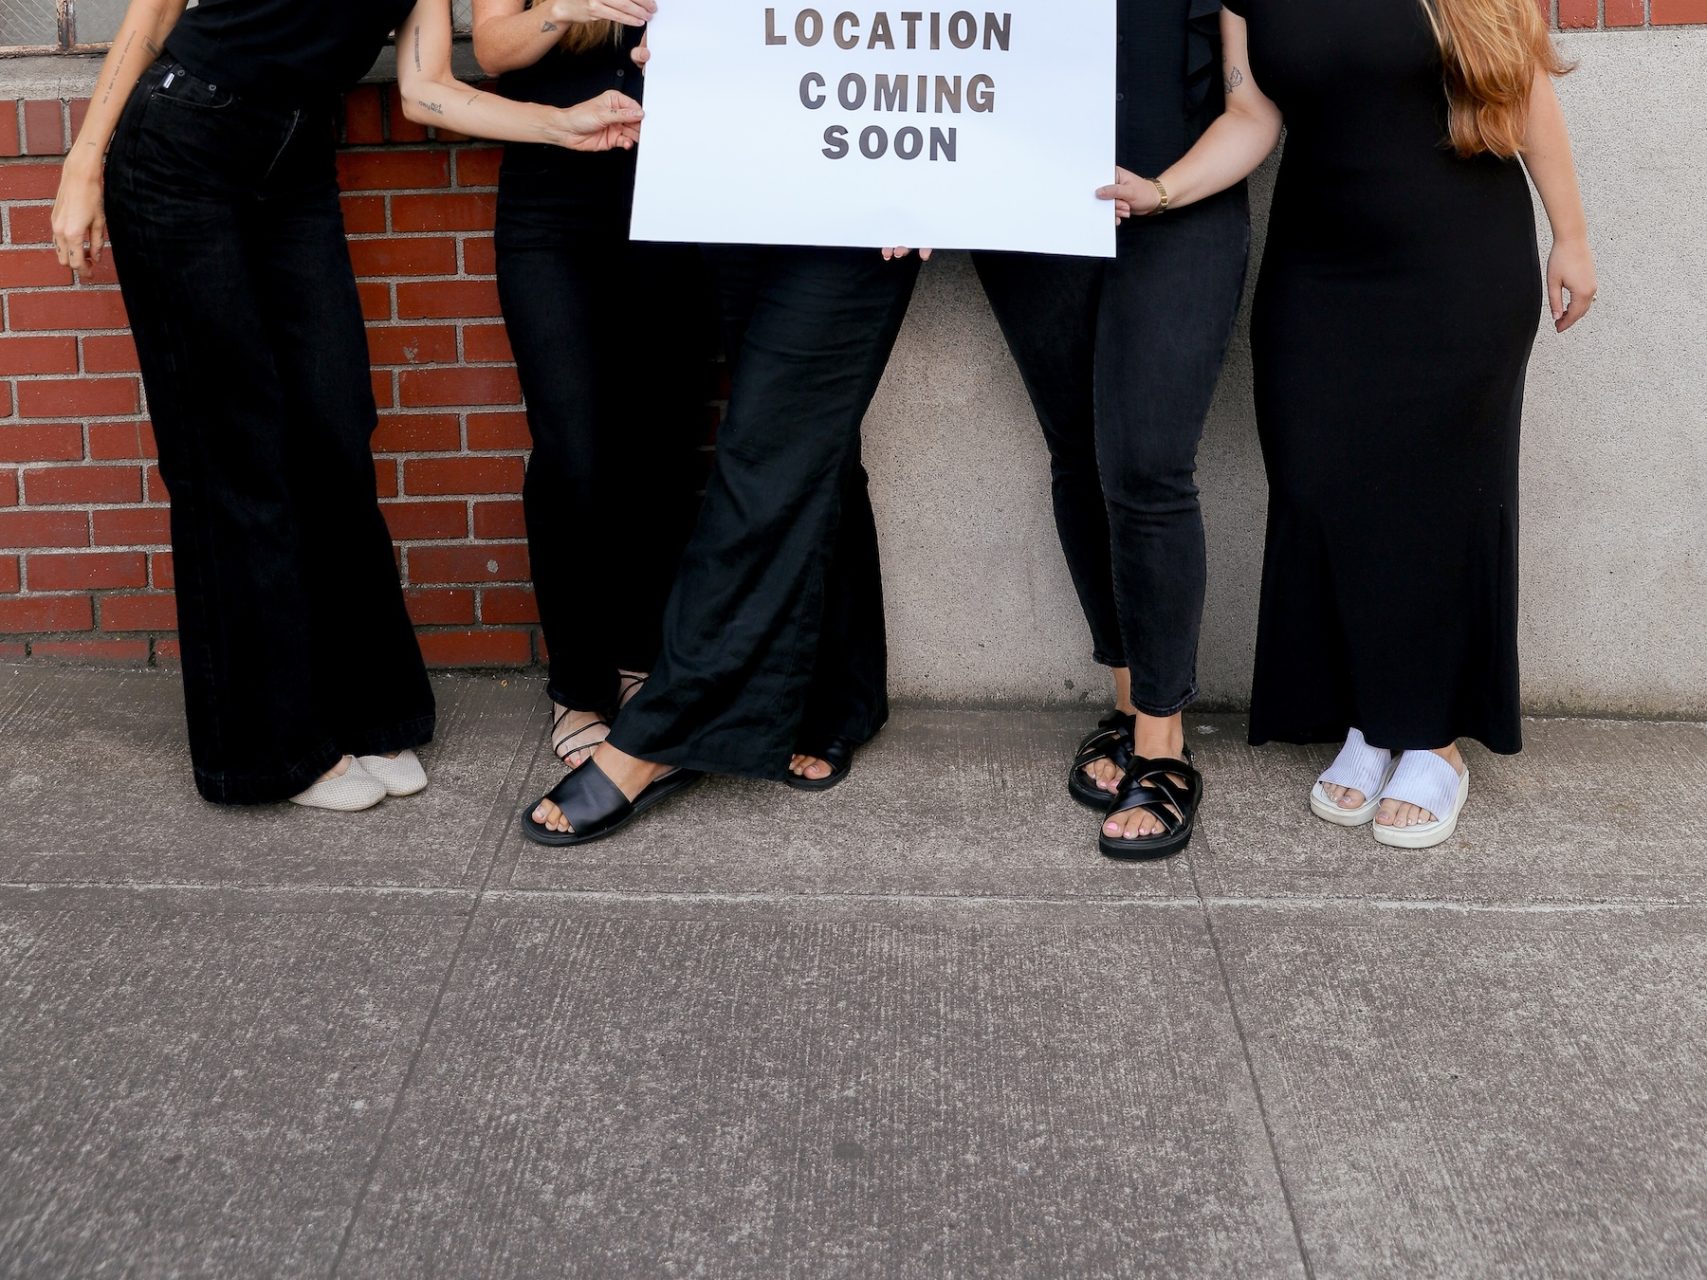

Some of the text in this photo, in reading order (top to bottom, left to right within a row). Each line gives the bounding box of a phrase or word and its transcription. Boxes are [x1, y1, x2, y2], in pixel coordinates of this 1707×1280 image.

[765, 8, 1011, 51] LOCATION
[799, 72, 995, 113] COMING
[822, 125, 957, 161] SOON
